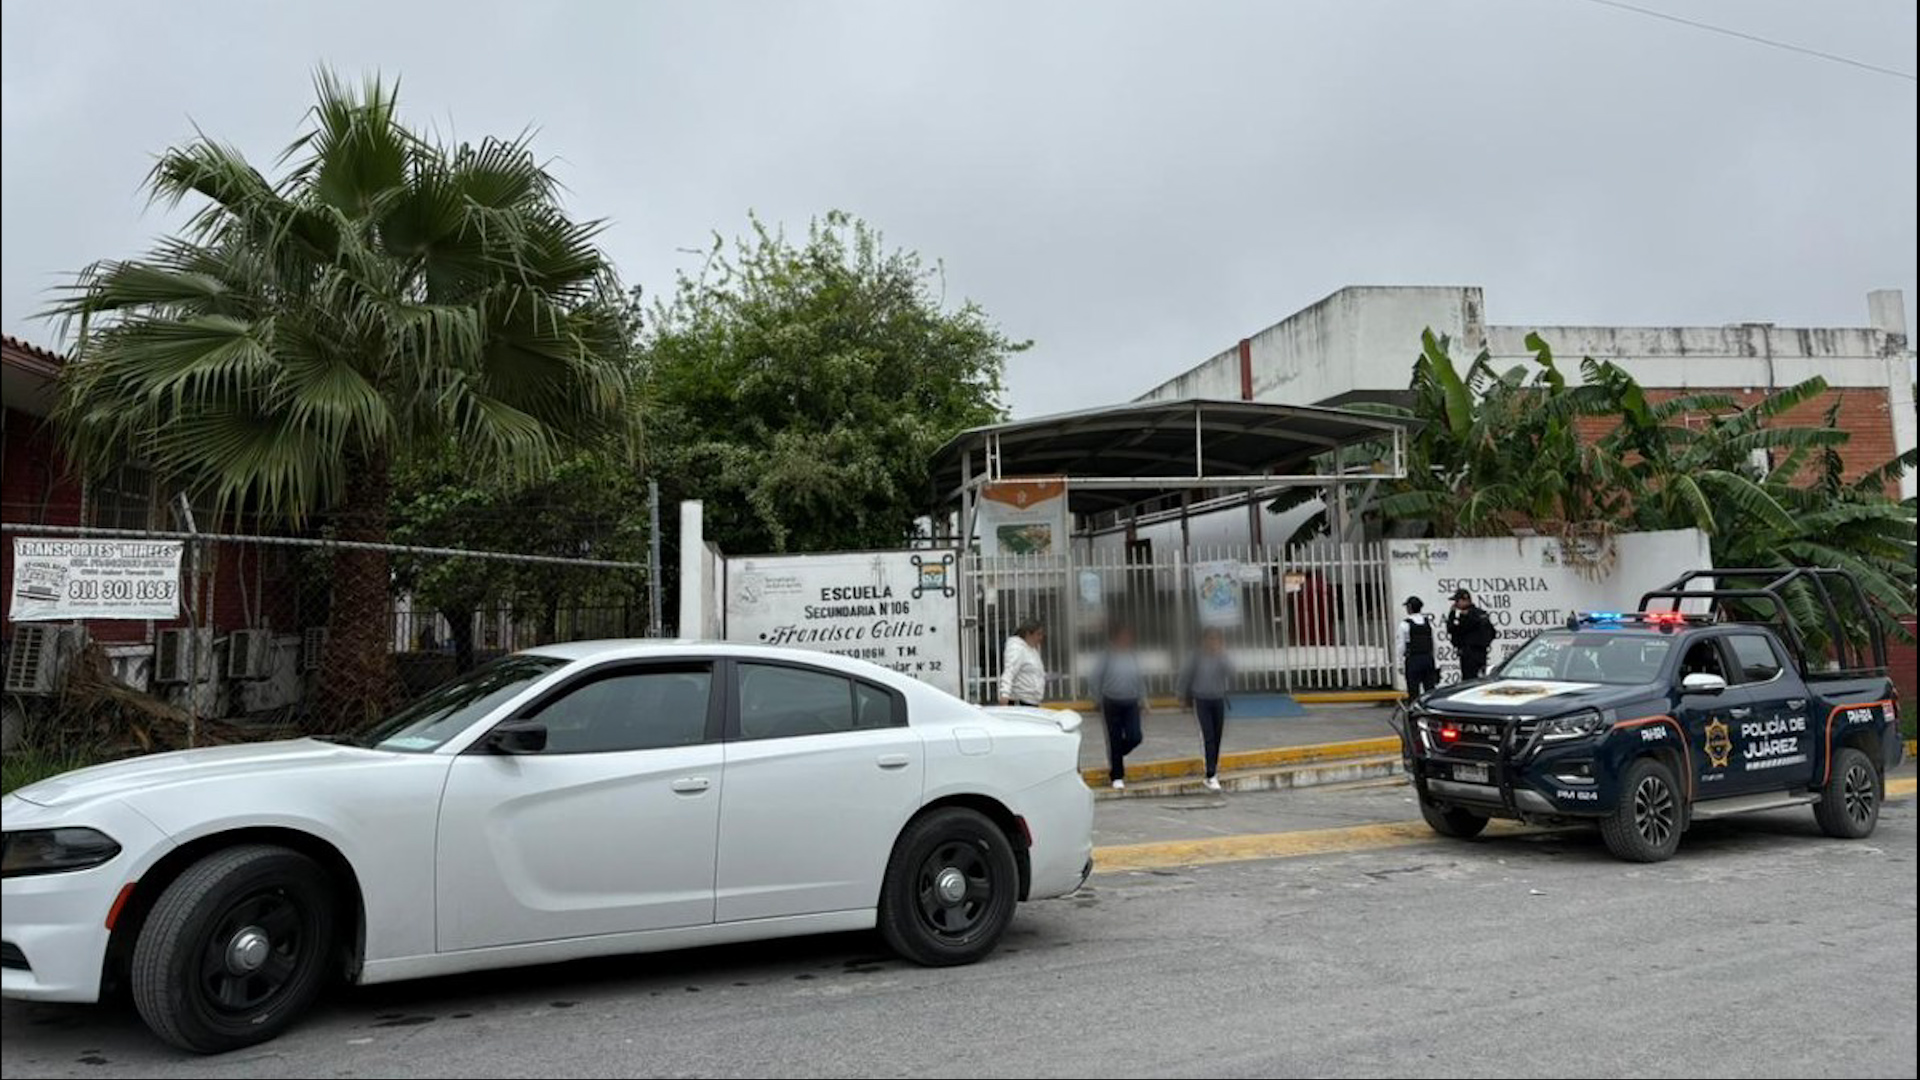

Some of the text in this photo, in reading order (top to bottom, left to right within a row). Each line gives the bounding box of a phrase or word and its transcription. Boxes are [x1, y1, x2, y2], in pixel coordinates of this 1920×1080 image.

[17, 542, 114, 557] TRANSPORTES
[69, 580, 176, 599] 811 301 1687
[821, 586, 892, 601] ESCUELA
[1438, 577, 1548, 594] SECUNDARIA
[769, 622, 863, 645] Francisco
[1741, 714, 1806, 738] POLICÍA DE
[1743, 736, 1798, 758] JUÁREZ
[1557, 790, 1575, 799] PM
